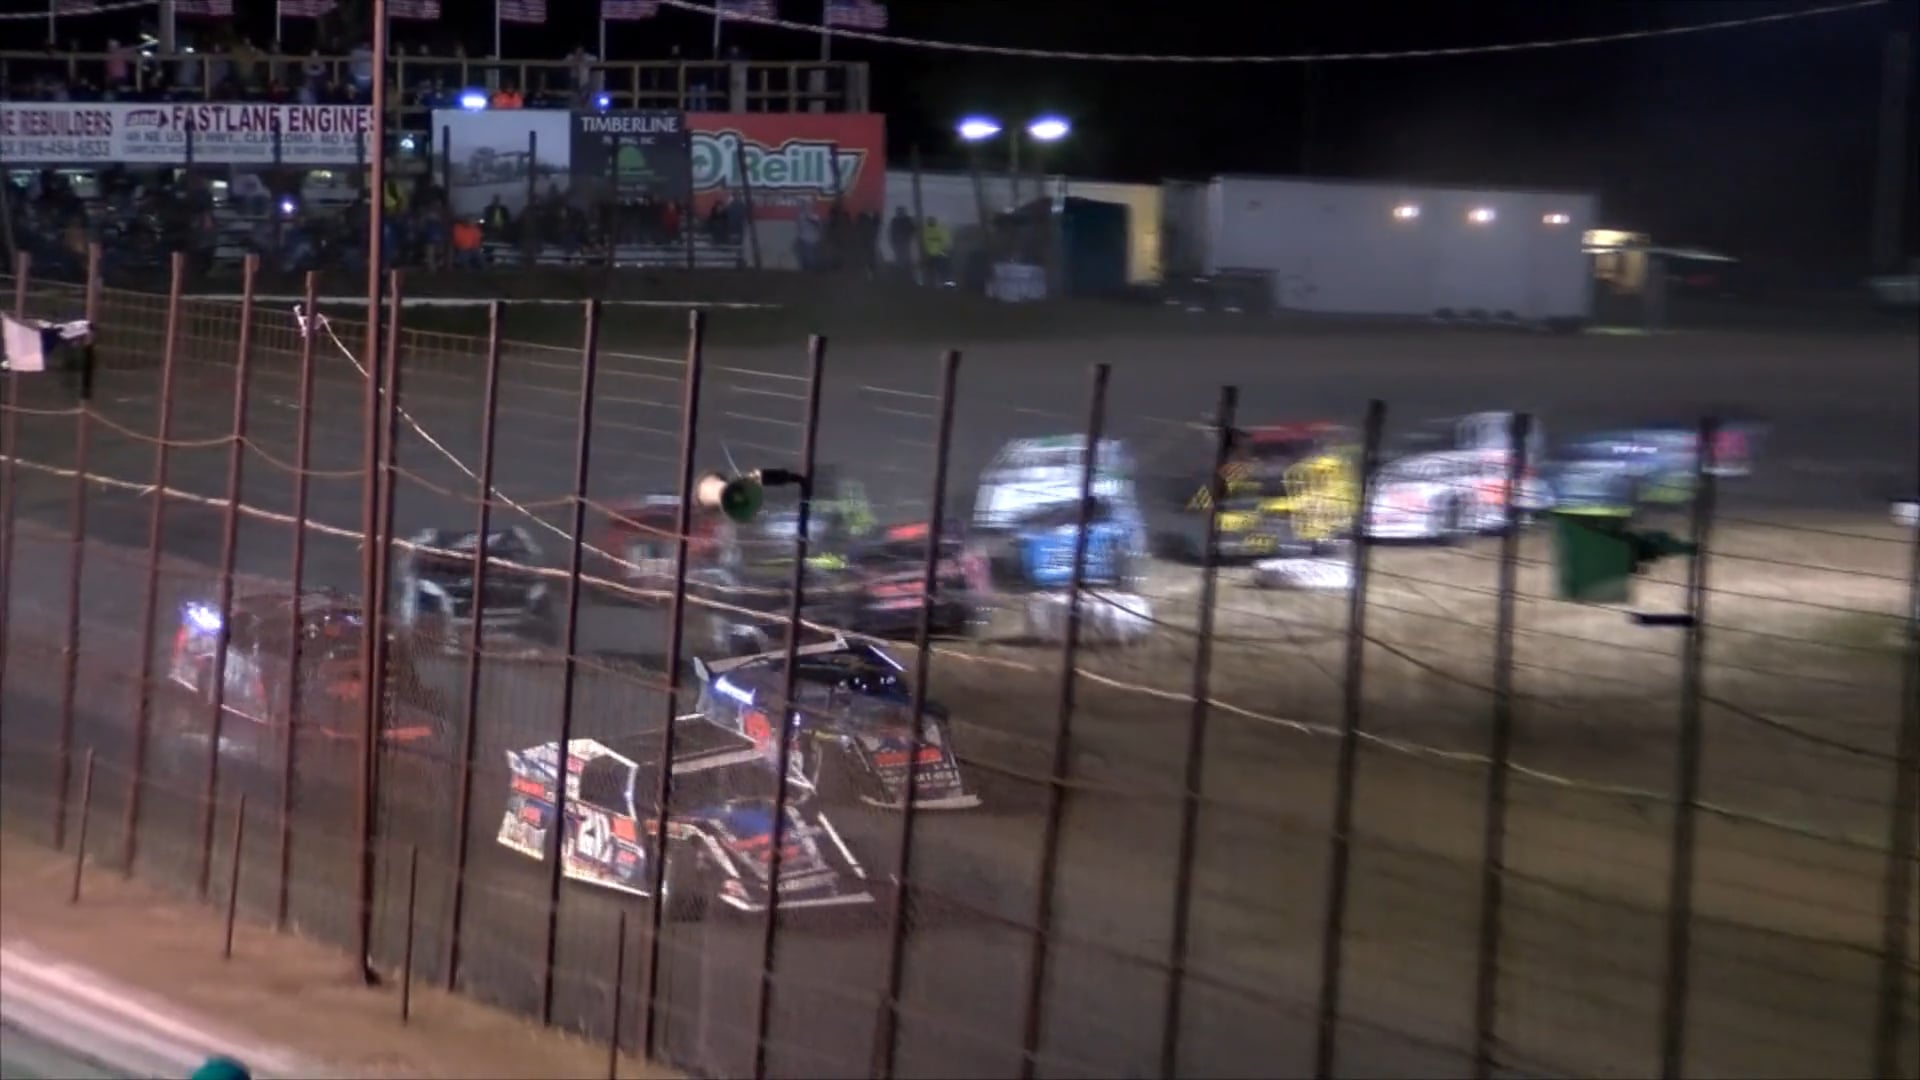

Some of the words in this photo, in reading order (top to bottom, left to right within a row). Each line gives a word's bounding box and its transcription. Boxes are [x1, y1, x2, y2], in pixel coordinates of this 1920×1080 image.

[19, 110, 113, 137] REBUILDERS
[172, 106, 281, 132] FASTLANE
[581, 116, 679, 133] TIMBERLINE
[692, 138, 858, 194] O'Reilly
